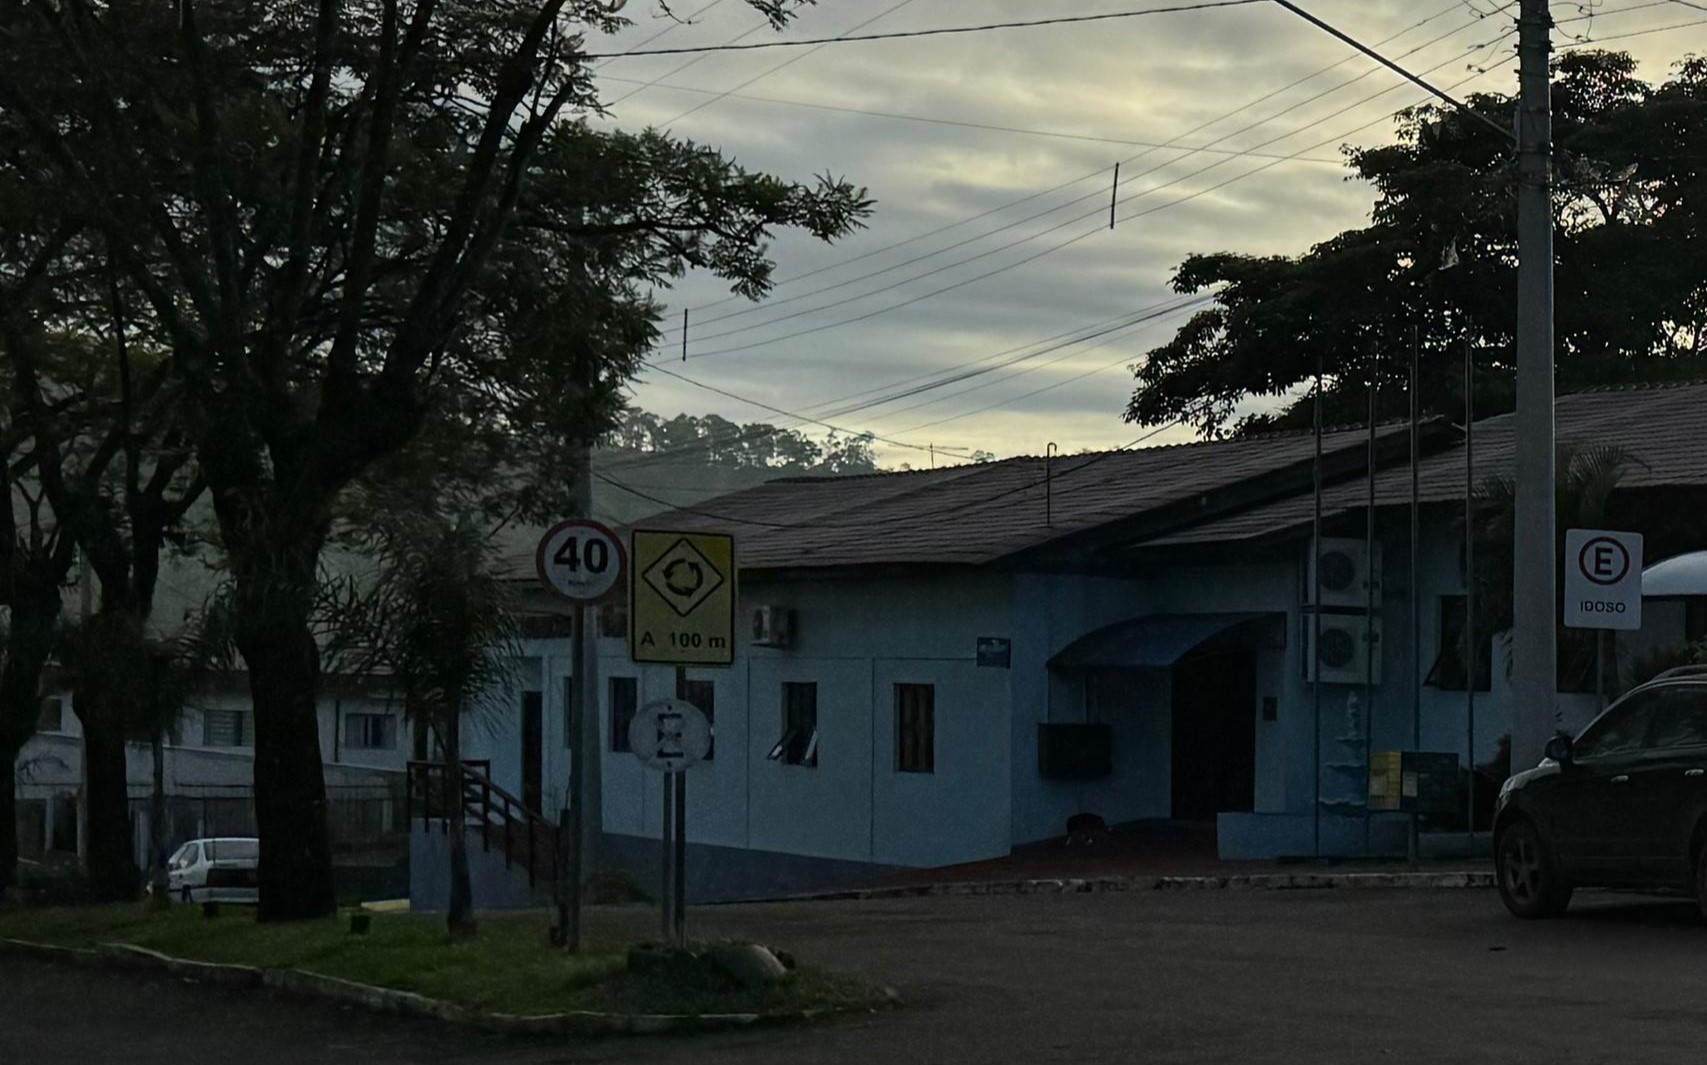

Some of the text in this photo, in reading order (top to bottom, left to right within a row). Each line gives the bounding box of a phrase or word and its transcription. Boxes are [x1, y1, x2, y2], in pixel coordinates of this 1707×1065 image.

[553, 536, 608, 574] 40
[1594, 546, 1613, 575] E
[1580, 600, 1626, 614] IDOSO
[640, 631, 726, 649] A 100 m
